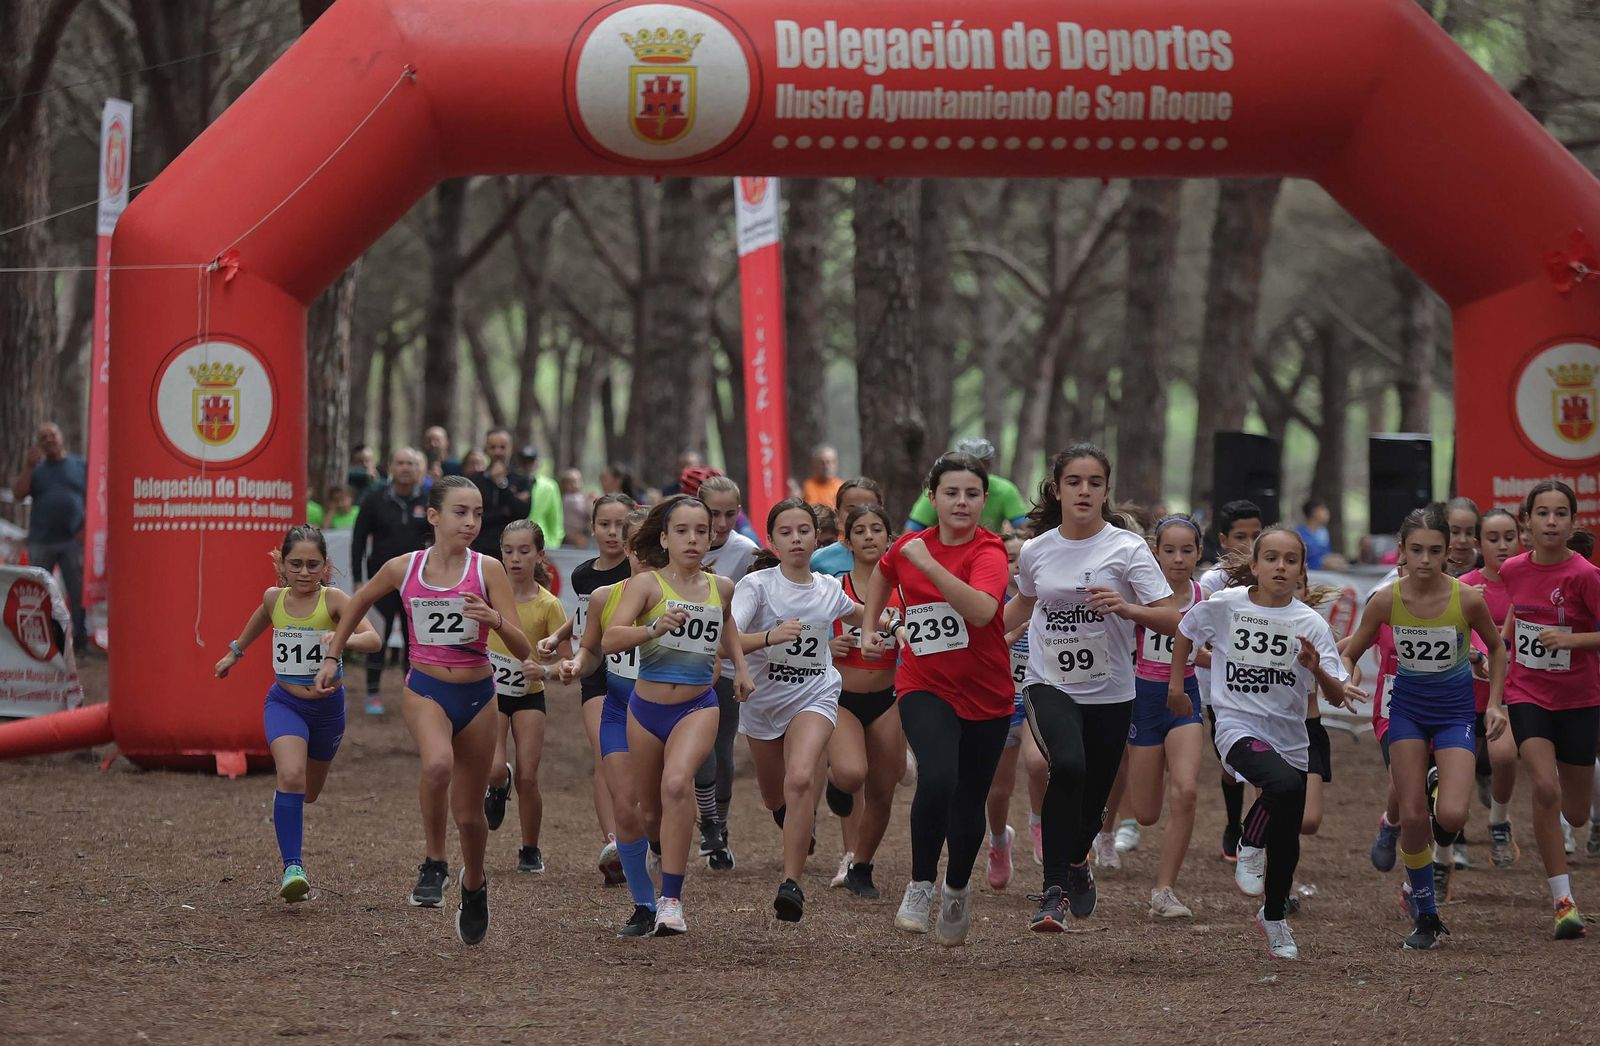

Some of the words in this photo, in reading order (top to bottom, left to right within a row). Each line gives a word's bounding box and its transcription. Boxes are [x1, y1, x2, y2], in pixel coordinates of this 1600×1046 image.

[774, 19, 996, 76] Delegación
[1001, 23, 1052, 70] de
[1058, 22, 1234, 76] Deportes
[775, 83, 864, 120] Ilustre
[867, 84, 1053, 123] Ayuntamiento
[1056, 85, 1091, 120] de
[1094, 85, 1145, 120] San
[1151, 86, 1232, 123] Roque
[133, 475, 213, 500] Delegación
[215, 476, 235, 498] de
[237, 476, 293, 500] Deportes
[163, 501, 235, 518] Ayuntamiento
[236, 502, 249, 517] de
[251, 502, 268, 518] San
[576, 607, 587, 625] 1
[677, 603, 704, 613] CROSS
[907, 605, 934, 616] CROSS
[428, 612, 464, 634] 22
[906, 615, 960, 643] 239
[1240, 615, 1269, 626] CROSS
[279, 631, 302, 639] CROSS
[1053, 637, 1079, 645] CROSS
[1234, 628, 1288, 656] 335
[1401, 628, 1428, 636] CROSS
[276, 643, 323, 664] 314
[785, 636, 819, 658] 32
[1400, 640, 1451, 661] 322
[490, 652, 512, 664] CROSS
[1057, 648, 1094, 672] 99
[490, 663, 526, 688] 22
[1013, 664, 1027, 683] 5
